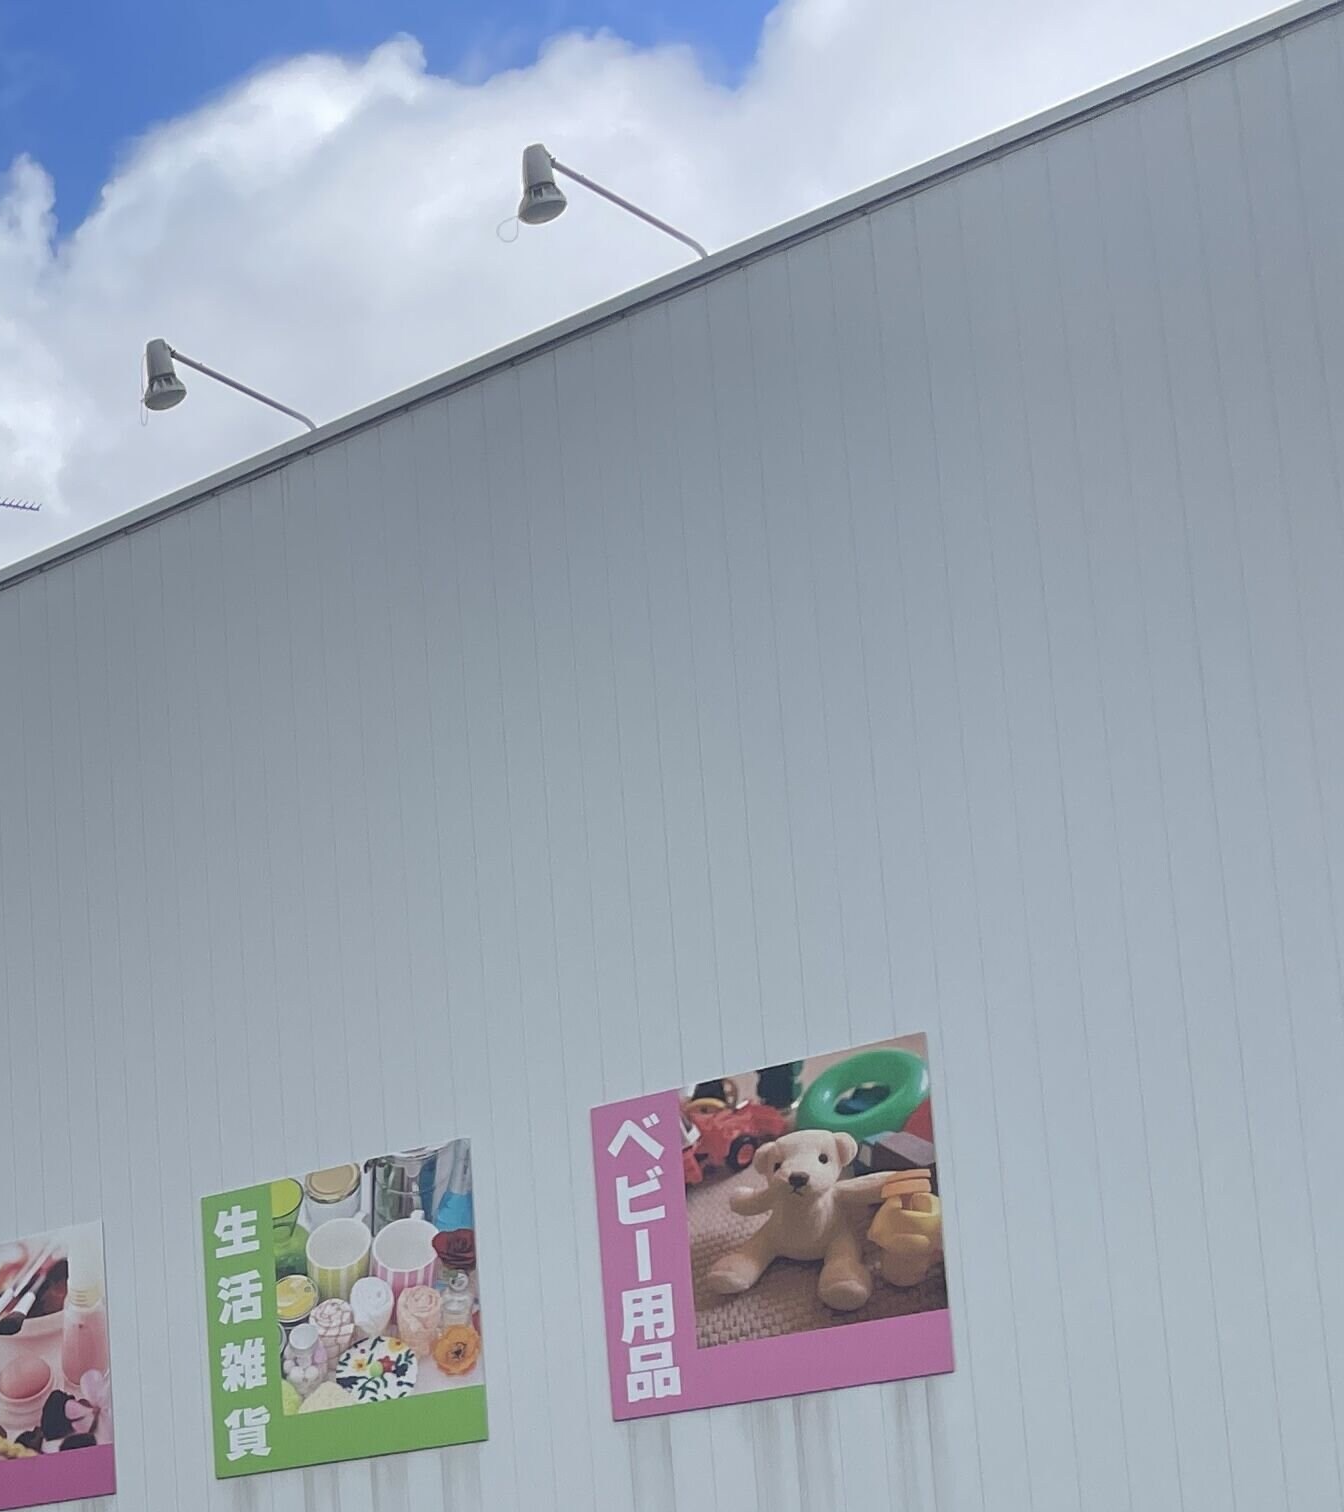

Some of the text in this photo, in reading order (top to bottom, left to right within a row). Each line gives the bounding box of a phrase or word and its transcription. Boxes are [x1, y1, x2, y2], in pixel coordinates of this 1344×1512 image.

[213, 1204, 271, 1463] 生活雑貨
[605, 1111, 683, 1405] ベビー用品
